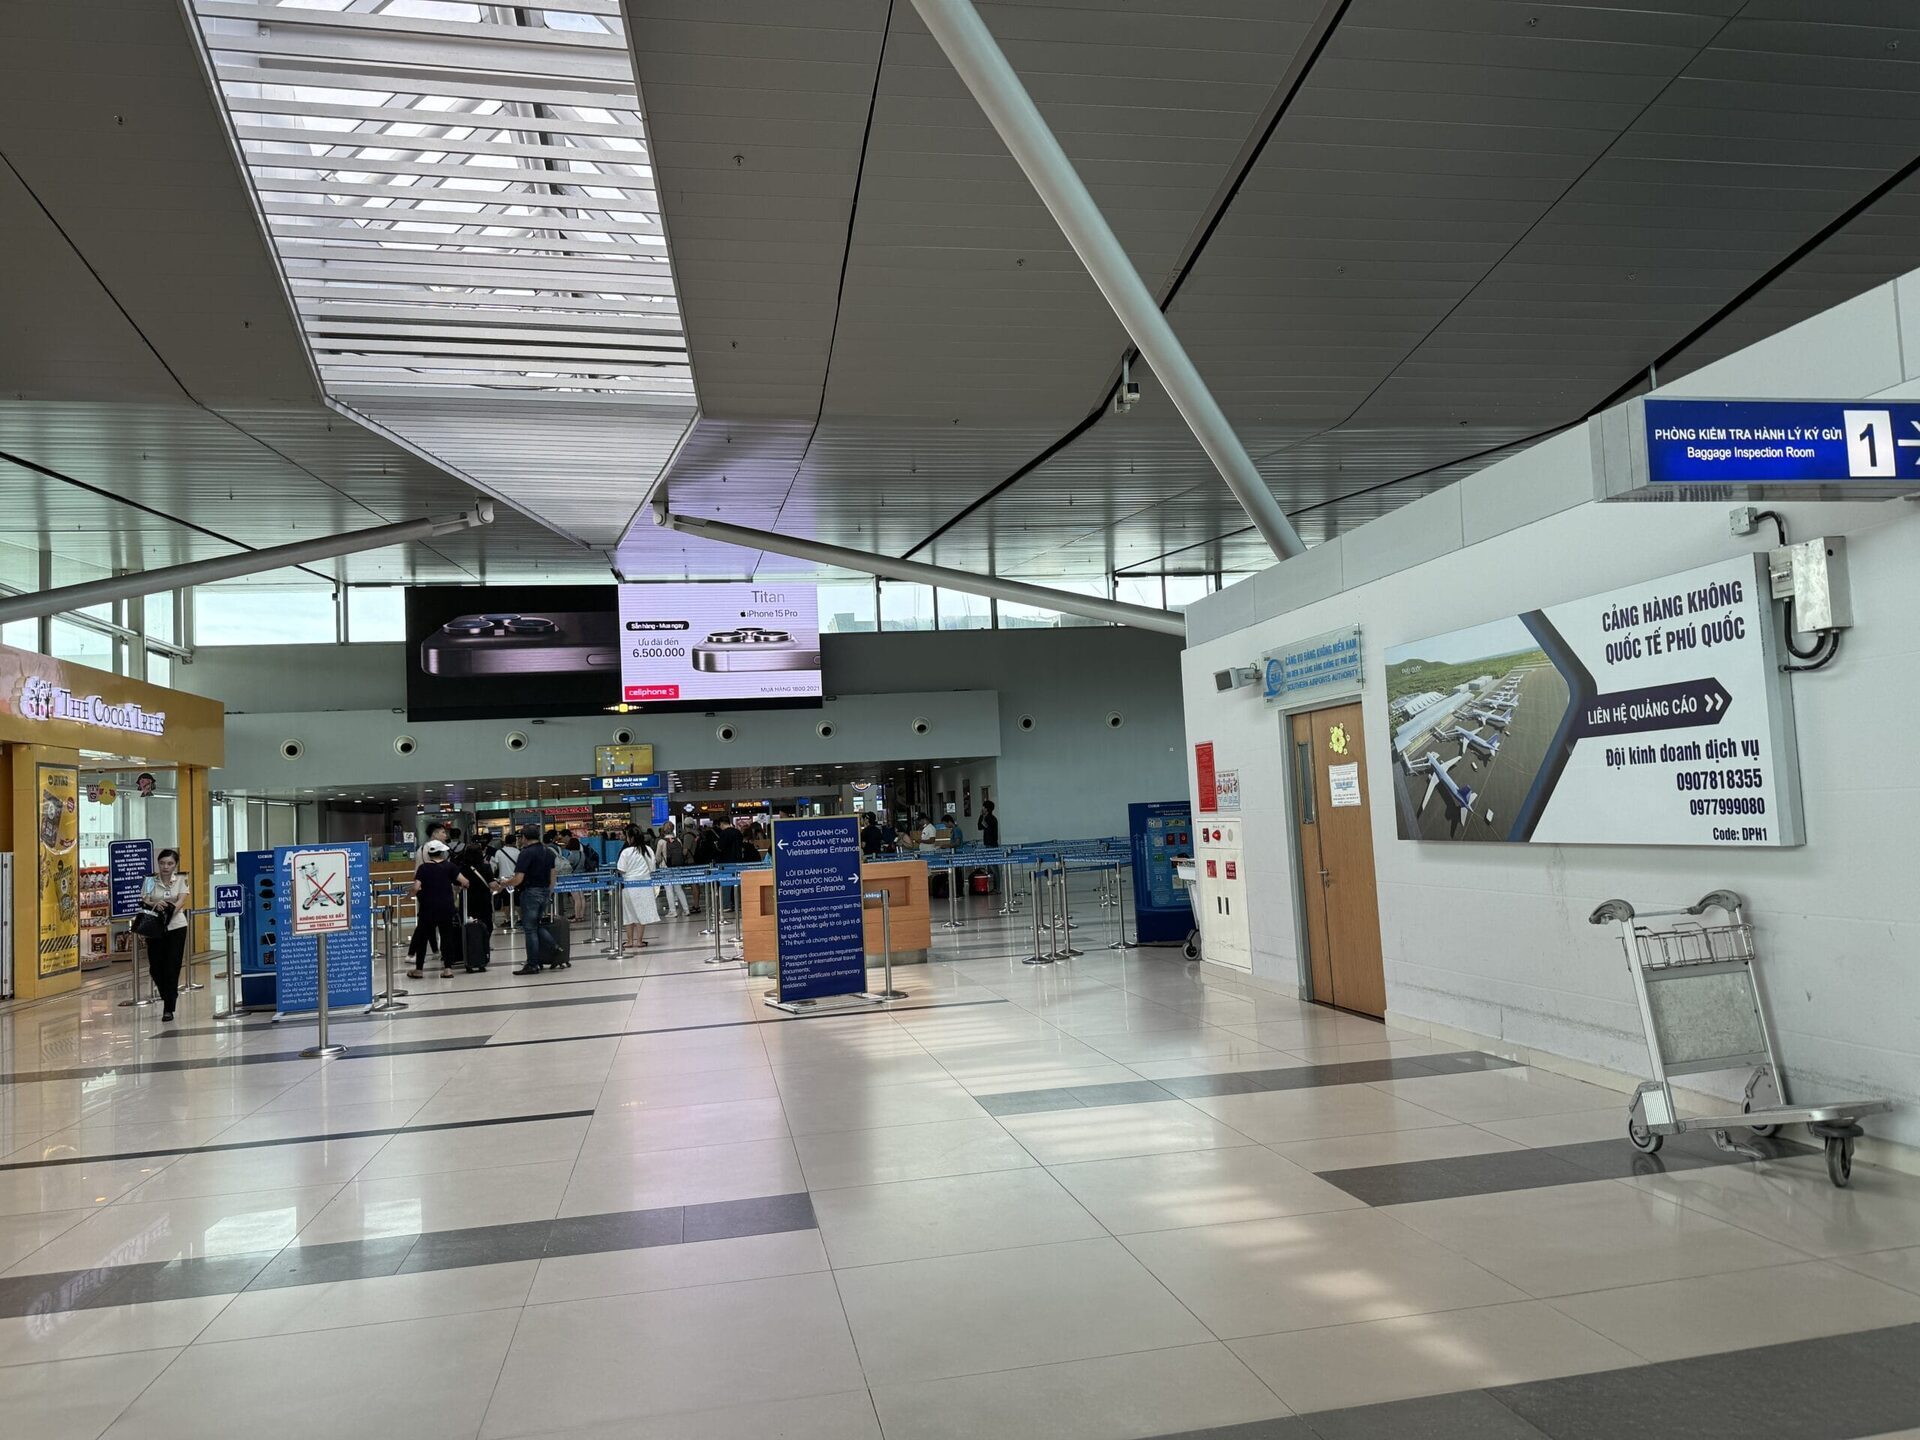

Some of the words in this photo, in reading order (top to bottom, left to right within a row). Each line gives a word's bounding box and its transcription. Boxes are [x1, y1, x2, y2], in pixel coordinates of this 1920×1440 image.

[1655, 427, 1696, 441] PHÒNG
[1729, 430, 1752, 440] TRA
[1754, 427, 1785, 440] HÀNH
[1788, 427, 1802, 440] LÝ
[1805, 427, 1819, 440] KÝ
[1859, 423, 1877, 468] 1
[1687, 447, 1732, 460] Baggage
[1734, 447, 1784, 460] Inspection
[1786, 447, 1815, 458] Room
[751, 591, 785, 603] Titan
[1602, 604, 1639, 632] CẢNG
[1644, 597, 1683, 623] HÀNG
[1687, 580, 1743, 614] KHÔNG
[747, 610, 774, 618] iPhone
[775, 610, 783, 618] 15
[1605, 632, 1642, 665] QUỐC
[1645, 627, 1662, 656] TẾ
[1666, 622, 1697, 652] PHÚ
[1701, 611, 1746, 647] QUỐC
[633, 648, 685, 658] 6.500.000
[60, 690, 89, 720] THE
[94, 698, 132, 728] COCOA
[133, 705, 165, 734] TREES
[1588, 707, 1610, 725] LIÊN
[1613, 705, 1628, 724] HỆ
[1630, 698, 1669, 722] QUẢNG
[1672, 695, 1697, 714] CÁO
[1606, 748, 1626, 770] Đội
[1629, 745, 1656, 765] kinh
[1661, 741, 1701, 762] doanh
[1705, 738, 1738, 763] dịch
[1741, 739, 1760, 760] vụ
[1677, 768, 1763, 791] 0907818355
[1690, 798, 1765, 816] 0977999080
[1713, 827, 1740, 841] Code:
[1742, 827, 1768, 841] DPH1
[787, 848, 828, 857] Vietnamese
[830, 846, 860, 854] Entrance
[778, 888, 815, 896] Foreigners
[816, 885, 846, 893] Entrance
[786, 960, 807, 968] Passport
[814, 956, 842, 964] international
